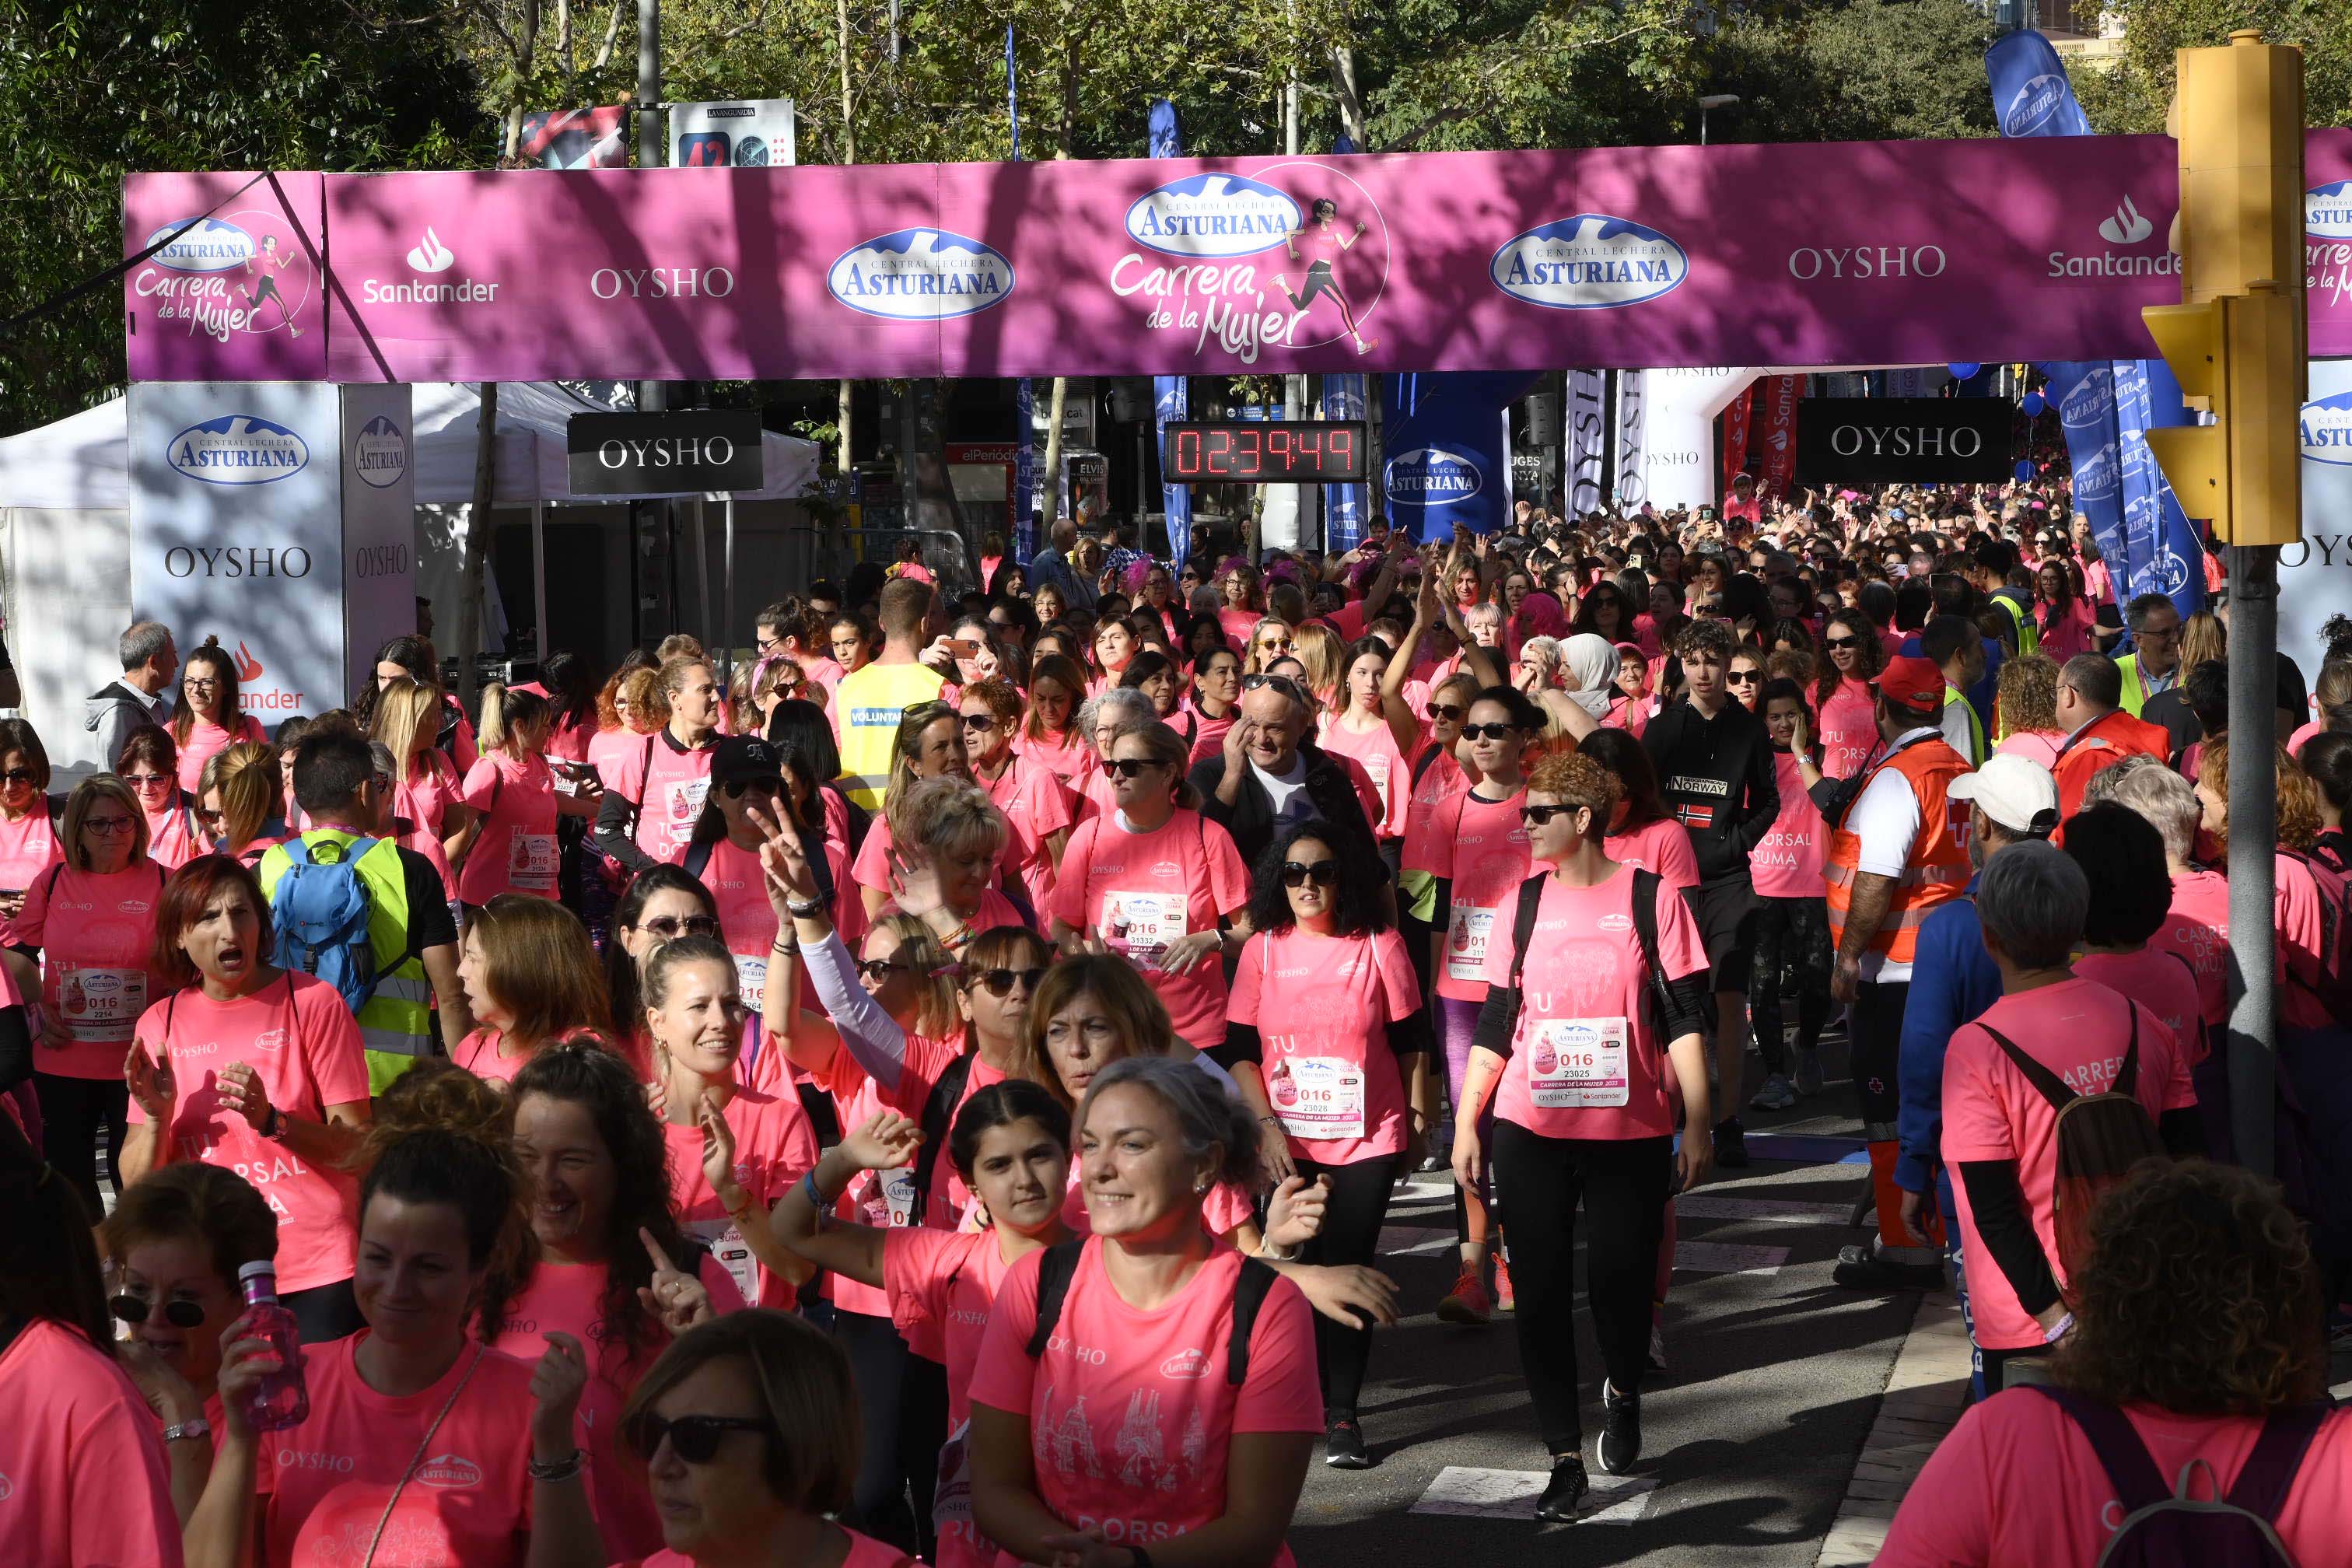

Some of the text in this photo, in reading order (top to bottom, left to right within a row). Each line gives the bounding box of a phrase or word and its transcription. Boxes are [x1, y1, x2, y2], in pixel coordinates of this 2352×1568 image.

[1139, 205, 1288, 236] ASTURIANA
[1535, 247, 1666, 258] CENTRAL LECHERA
[1788, 244, 1947, 280] OYSHO
[871, 258, 995, 269] CENTRAL LECHERA
[1505, 250, 1673, 286] ASTURIANA
[135, 268, 226, 298] Carrera
[590, 267, 733, 299] OYSHO
[842, 263, 1000, 297] ASTURIANA
[1110, 253, 1258, 297] Carrera
[2321, 267, 2335, 288] la
[362, 278, 499, 304] Santander
[158, 294, 261, 343] de la Mujer
[1146, 292, 1311, 365] de la Mujer
[199, 439, 295, 447] CENTRAL LECHERA
[1830, 425, 1982, 459] OYSHO
[177, 440, 299, 467] ASTURIANA
[358, 443, 403, 471] ASTURIANA
[599, 436, 733, 469] OYSHO
[1178, 430, 1352, 474] 02:39:49
[1080, 464, 1104, 474] ELVIS
[1387, 471, 1475, 493] ASTURIANA
[2277, 534, 2352, 568] OY
[164, 546, 311, 579] OYSHO
[355, 544, 408, 579] OYSHO
[1826, 730, 1843, 743] TU
[1672, 778, 1726, 794] NORWAY
[531, 856, 548, 865] 016
[1753, 850, 1797, 866] SUMA
[1091, 864, 1125, 874] OYSHO
[1126, 905, 1160, 915] ASTURIANA
[1129, 922, 1157, 935] 016
[1130, 936, 1154, 945] 31332
[2193, 942, 2214, 957] DE
[1272, 968, 1308, 978] OYSHO
[2195, 956, 2227, 975] MUJ
[86, 979, 119, 988] ASTURIANA
[88, 996, 118, 1010] 016
[1267, 1034, 1296, 1053] TU
[1558, 1034, 1595, 1043] ASTURIANA
[173, 1041, 218, 1058] OYSHO
[1560, 1053, 1594, 1066] 016
[1298, 1069, 1334, 1078] ASTURIANA
[1564, 1069, 1591, 1078] 23025
[1300, 1089, 1332, 1101] 016
[1303, 1104, 1328, 1113] 23028
[180, 1132, 213, 1159] TU
[1046, 1335, 1107, 1367] OYHO
[277, 1447, 355, 1474] OYSHO
[420, 1466, 477, 1484] ASTURIANA
